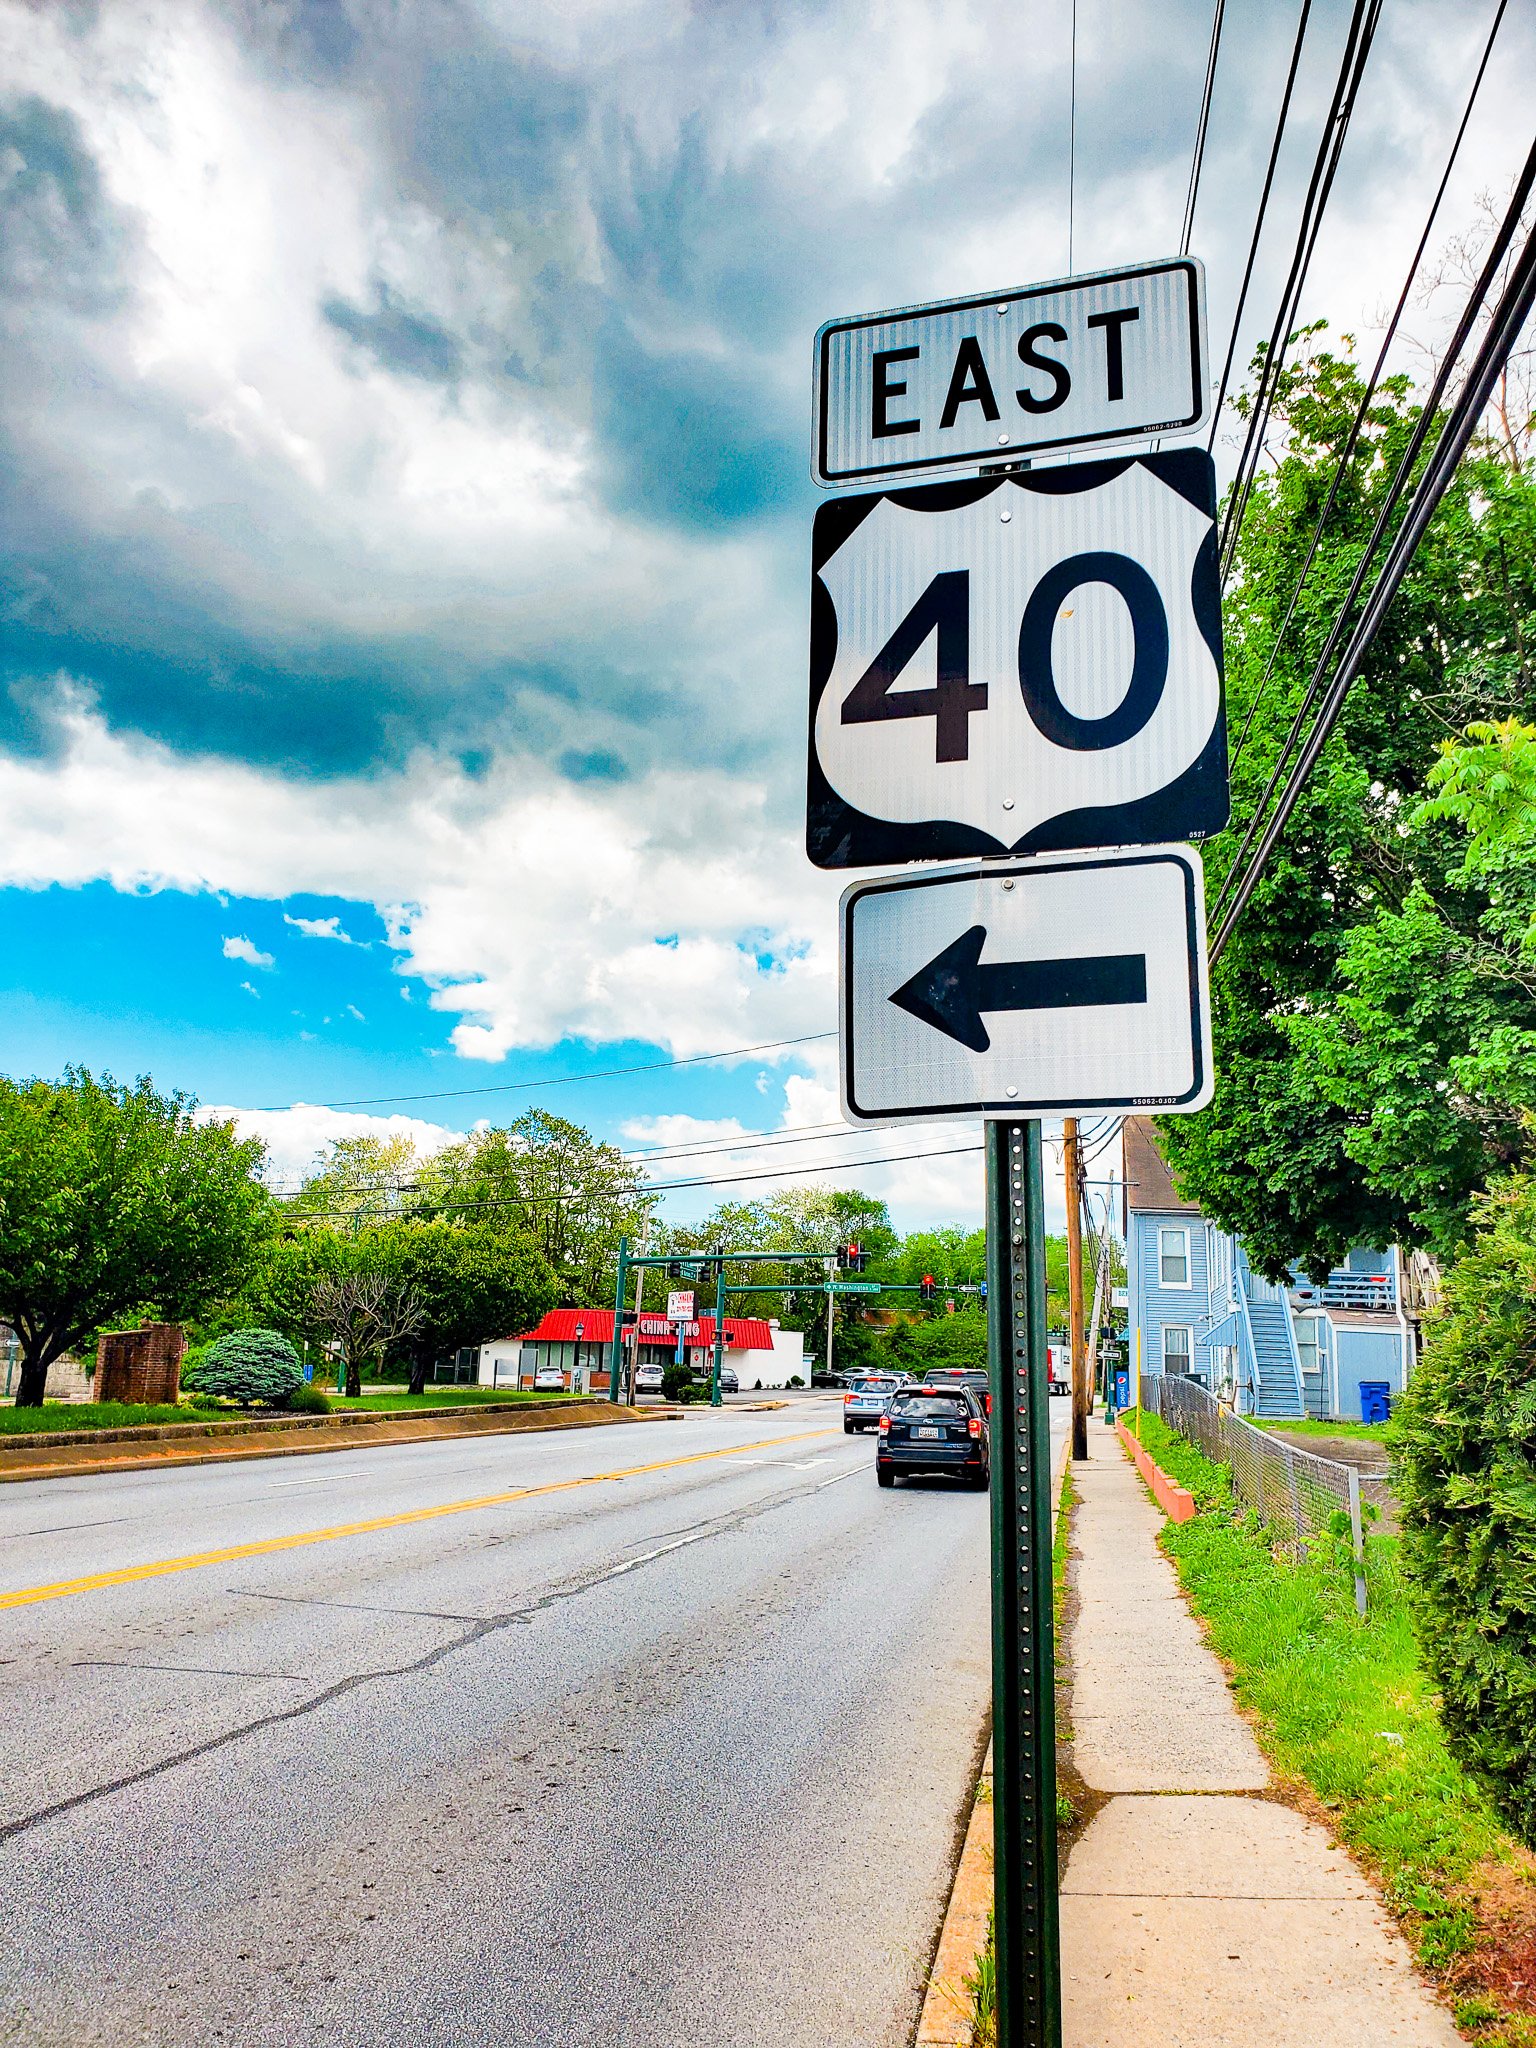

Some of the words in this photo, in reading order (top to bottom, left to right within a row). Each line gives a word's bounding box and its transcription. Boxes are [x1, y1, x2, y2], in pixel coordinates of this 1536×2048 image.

[872, 307, 1139, 439] EAST
[841, 551, 1169, 763] 40
[1189, 830, 1206, 838] 0527
[640, 1320, 670, 1335] CHINA
[1119, 1386, 1127, 1405] pepsi
